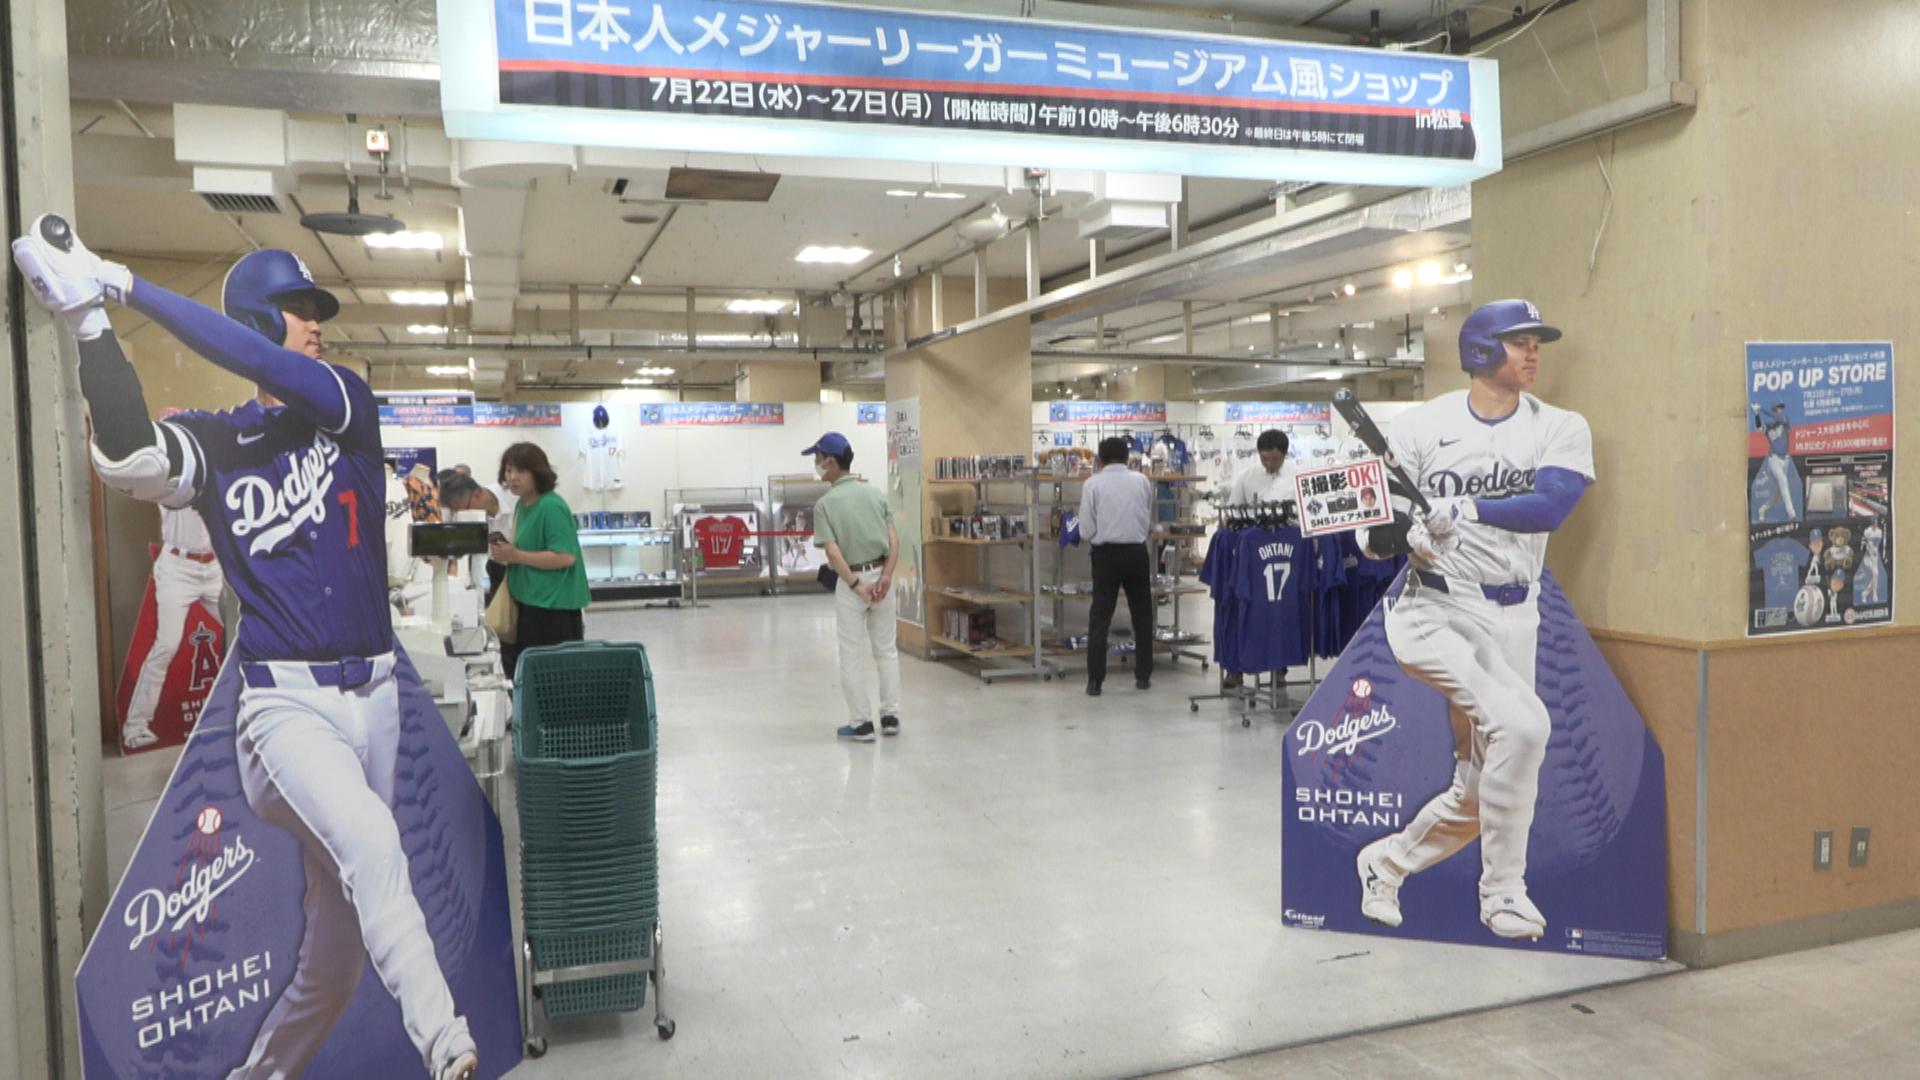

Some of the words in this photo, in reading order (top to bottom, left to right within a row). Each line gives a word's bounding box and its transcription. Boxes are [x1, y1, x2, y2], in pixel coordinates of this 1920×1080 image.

[1752, 370, 1794, 393] POP
[1798, 366, 1824, 389] UP
[1828, 361, 1888, 386] STORE
[1258, 543, 1294, 560] OHTANI
[1263, 562, 1291, 602] 17
[1296, 704, 1397, 757] Dodgers
[1296, 787, 1402, 808] SHOHEI
[1298, 807, 1399, 828] OHTANI
[124, 835, 255, 951] Dodgers
[131, 951, 273, 1023] SHOHEI
[138, 979, 271, 1050] OHTANI
